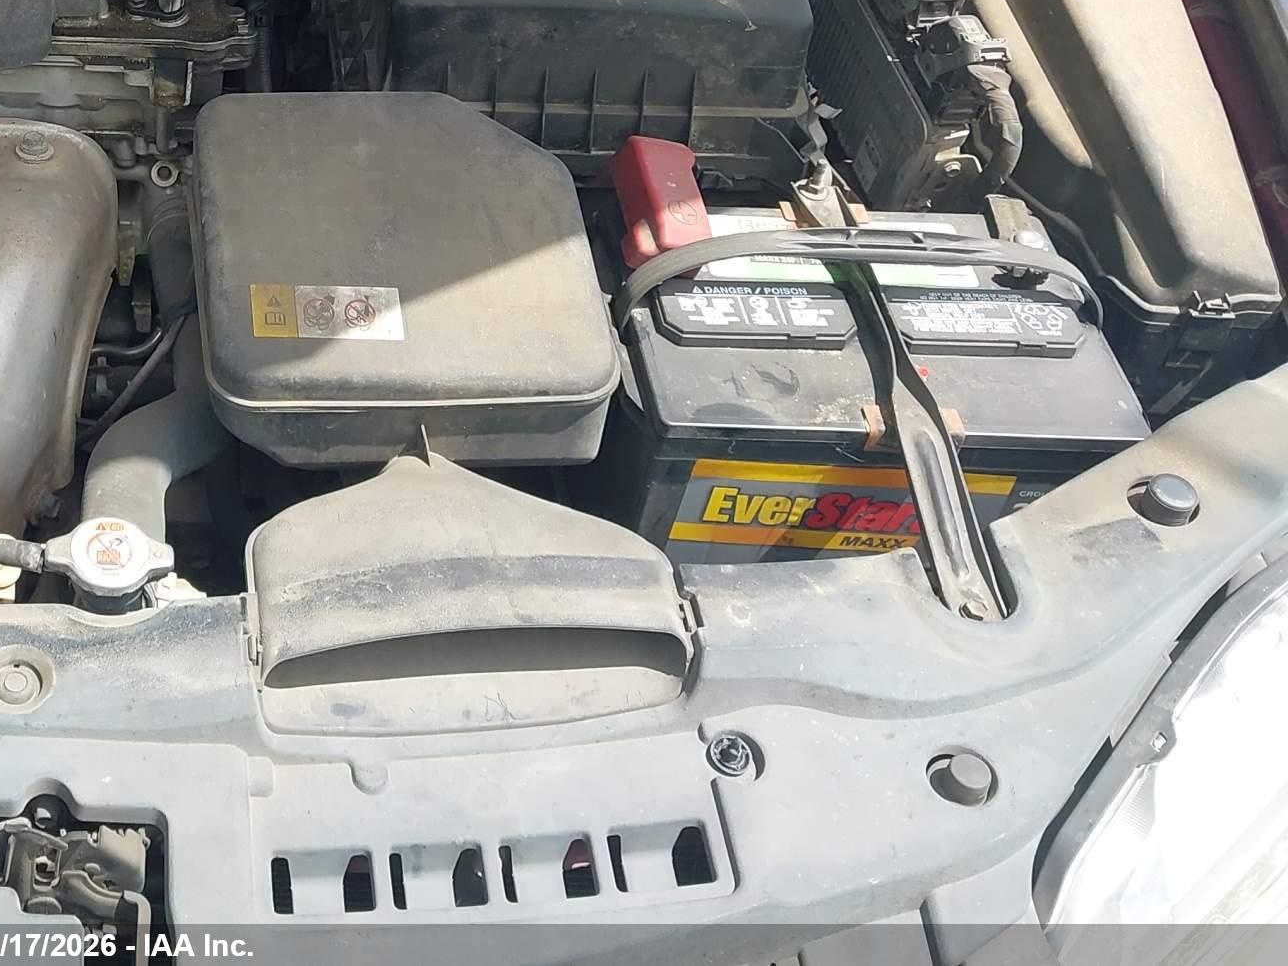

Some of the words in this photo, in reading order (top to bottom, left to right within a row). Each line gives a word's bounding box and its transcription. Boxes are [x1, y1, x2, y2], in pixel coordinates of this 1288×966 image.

[703, 285, 752, 295] DANGER
[763, 286, 808, 296] POISON
[838, 535, 907, 549] MAXX
